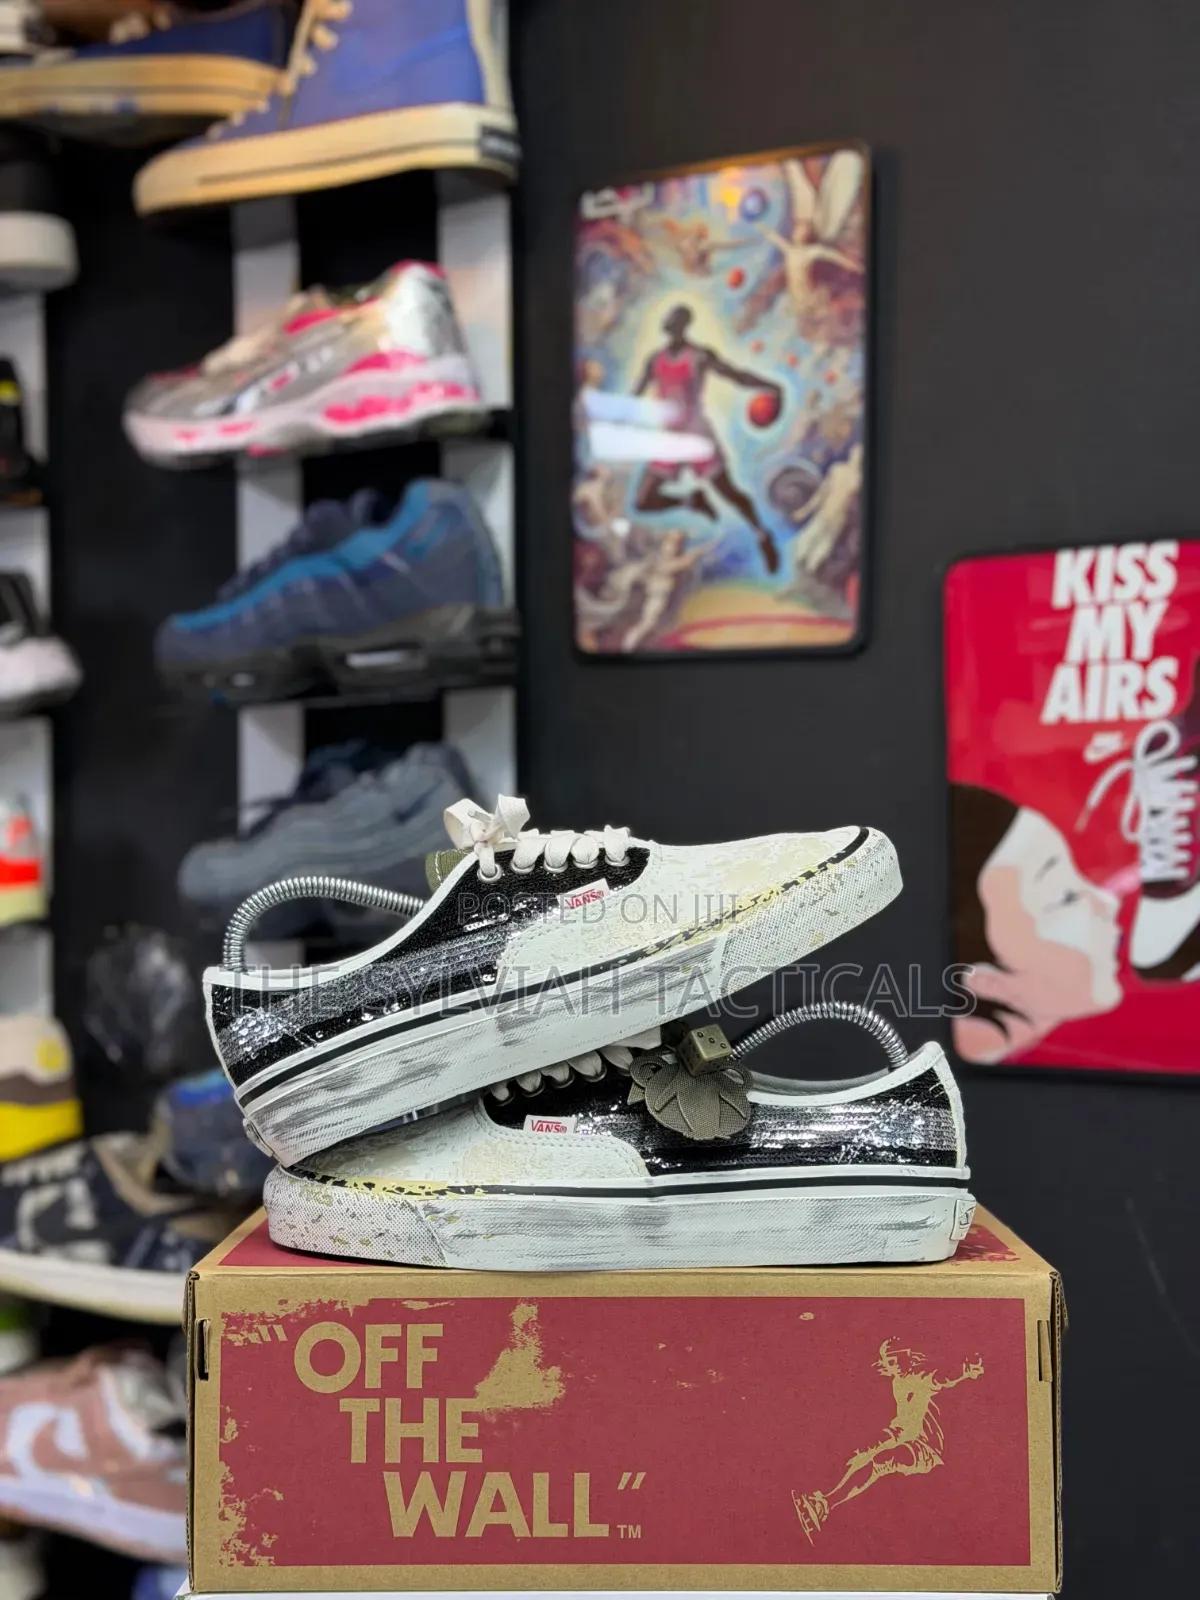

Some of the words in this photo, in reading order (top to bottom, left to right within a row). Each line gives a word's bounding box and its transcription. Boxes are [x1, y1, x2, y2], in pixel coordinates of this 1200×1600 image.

[1052, 541, 1178, 609] KISS
[1064, 600, 1169, 664] MY
[1040, 657, 1178, 724] AIRS
[339, 1397, 483, 1464] THE
